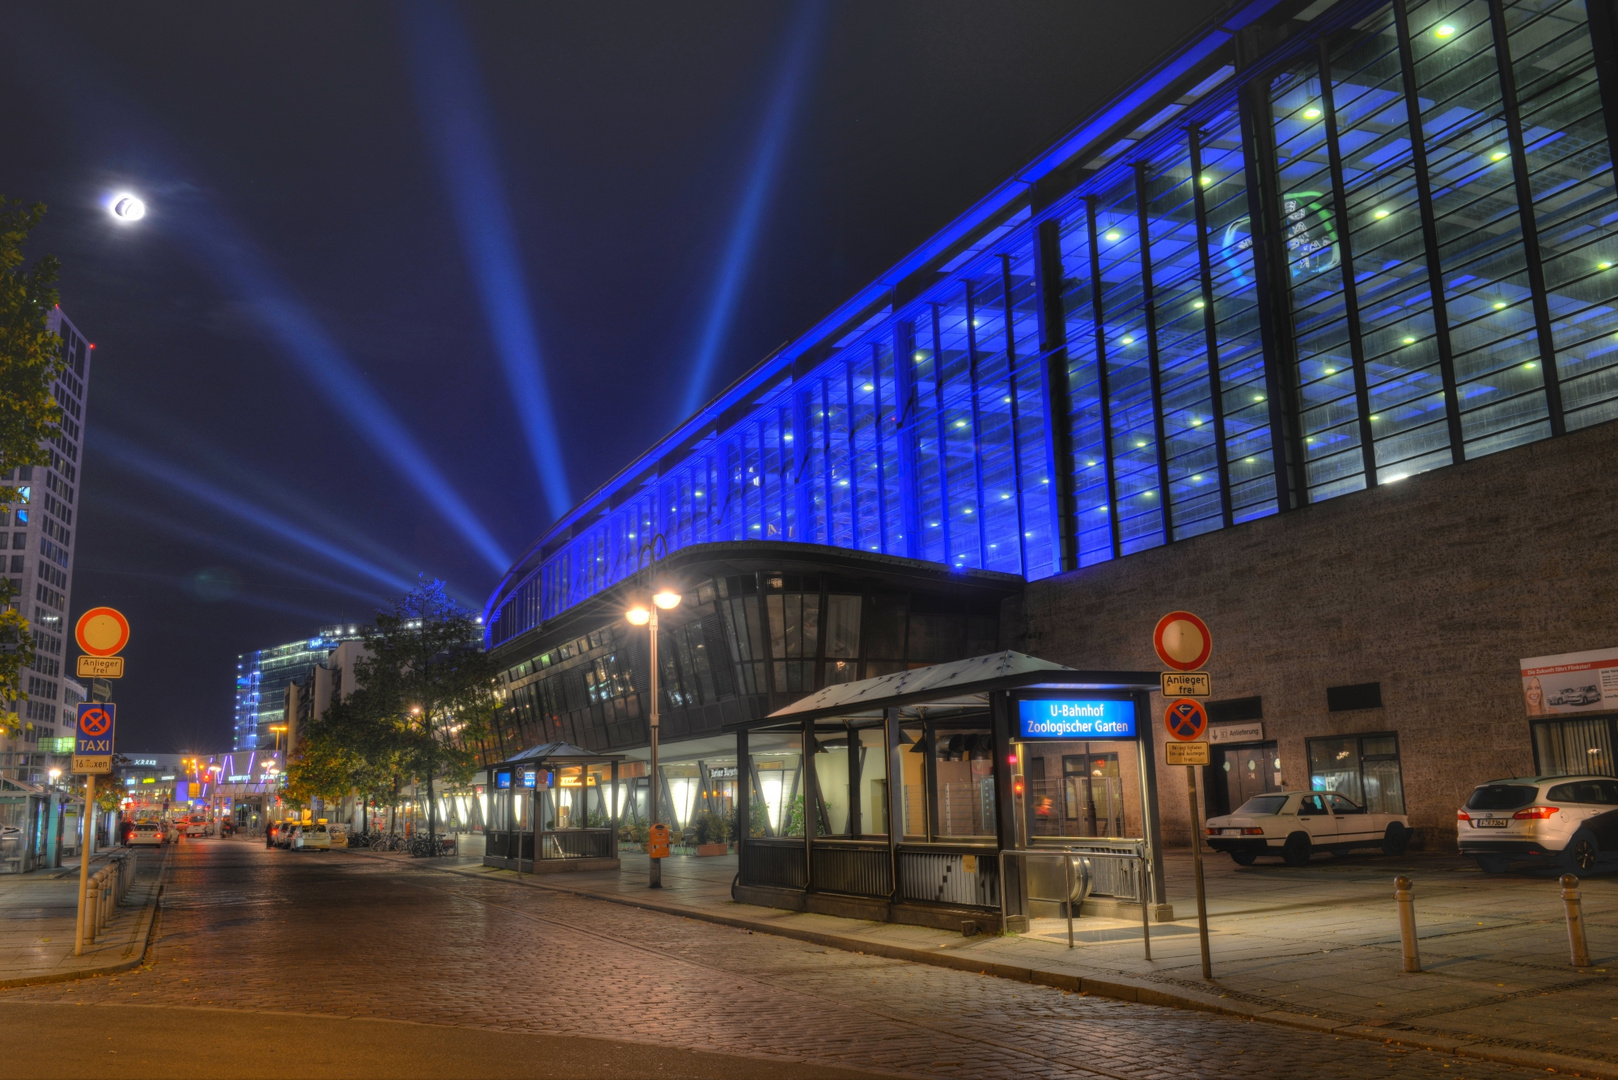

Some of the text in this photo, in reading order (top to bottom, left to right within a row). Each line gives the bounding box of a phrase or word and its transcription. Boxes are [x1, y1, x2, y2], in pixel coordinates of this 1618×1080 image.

[83, 659, 118, 668] Anlieger
[93, 666, 108, 674] frei
[1166, 675, 1206, 685] Anlieger
[1179, 686, 1195, 694] frei
[1050, 704, 1104, 717] U-Bahnhof
[1027, 720, 1129, 736] Zoologischer Garten
[1229, 729, 1259, 737] Anlieferung
[79, 740, 110, 752] TAXI
[76, 759, 84, 768] 16
